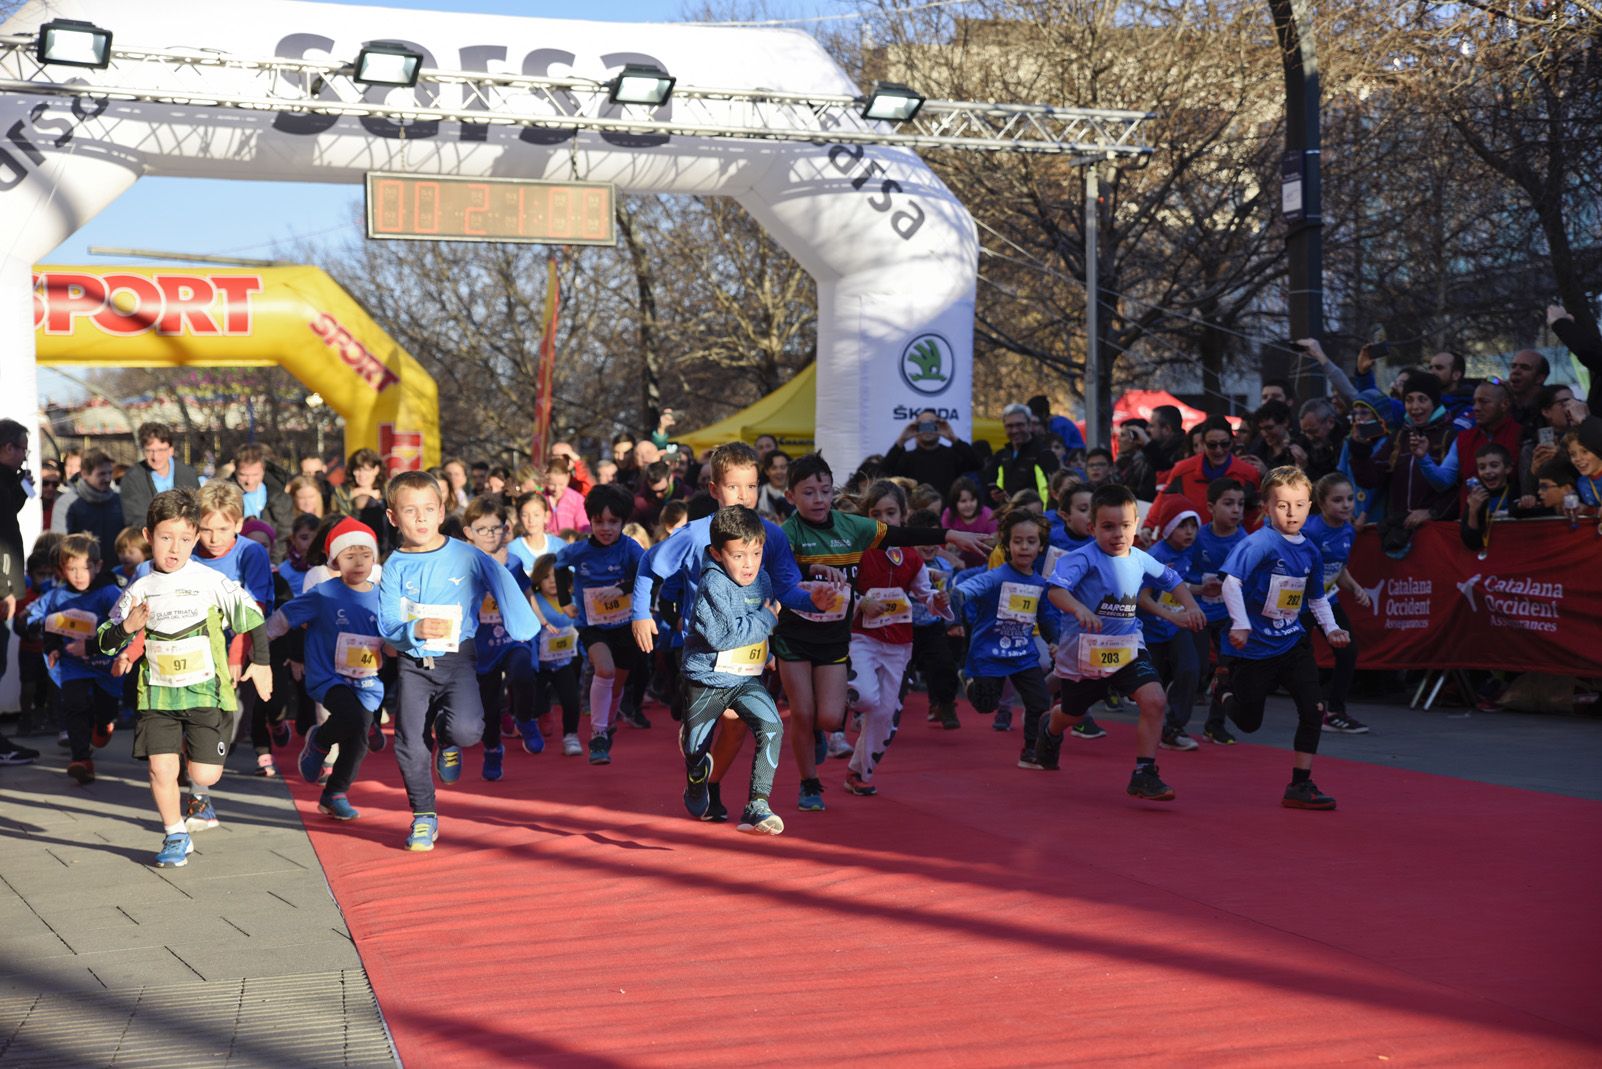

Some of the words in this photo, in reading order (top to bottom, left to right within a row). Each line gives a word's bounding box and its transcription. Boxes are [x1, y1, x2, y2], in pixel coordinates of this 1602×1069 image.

[272, 32, 673, 148] sarsa
[308, 311, 401, 395] SPORT
[893, 404, 960, 421] ŠKDA
[1387, 577, 1433, 597] Catalana
[1483, 575, 1564, 599] Catalana
[1385, 599, 1431, 616] Occident
[1483, 594, 1560, 619] Occident
[360, 653, 374, 665] 44
[749, 648, 761, 660] 61
[1101, 652, 1120, 664] 203
[173, 659, 188, 671] 97
